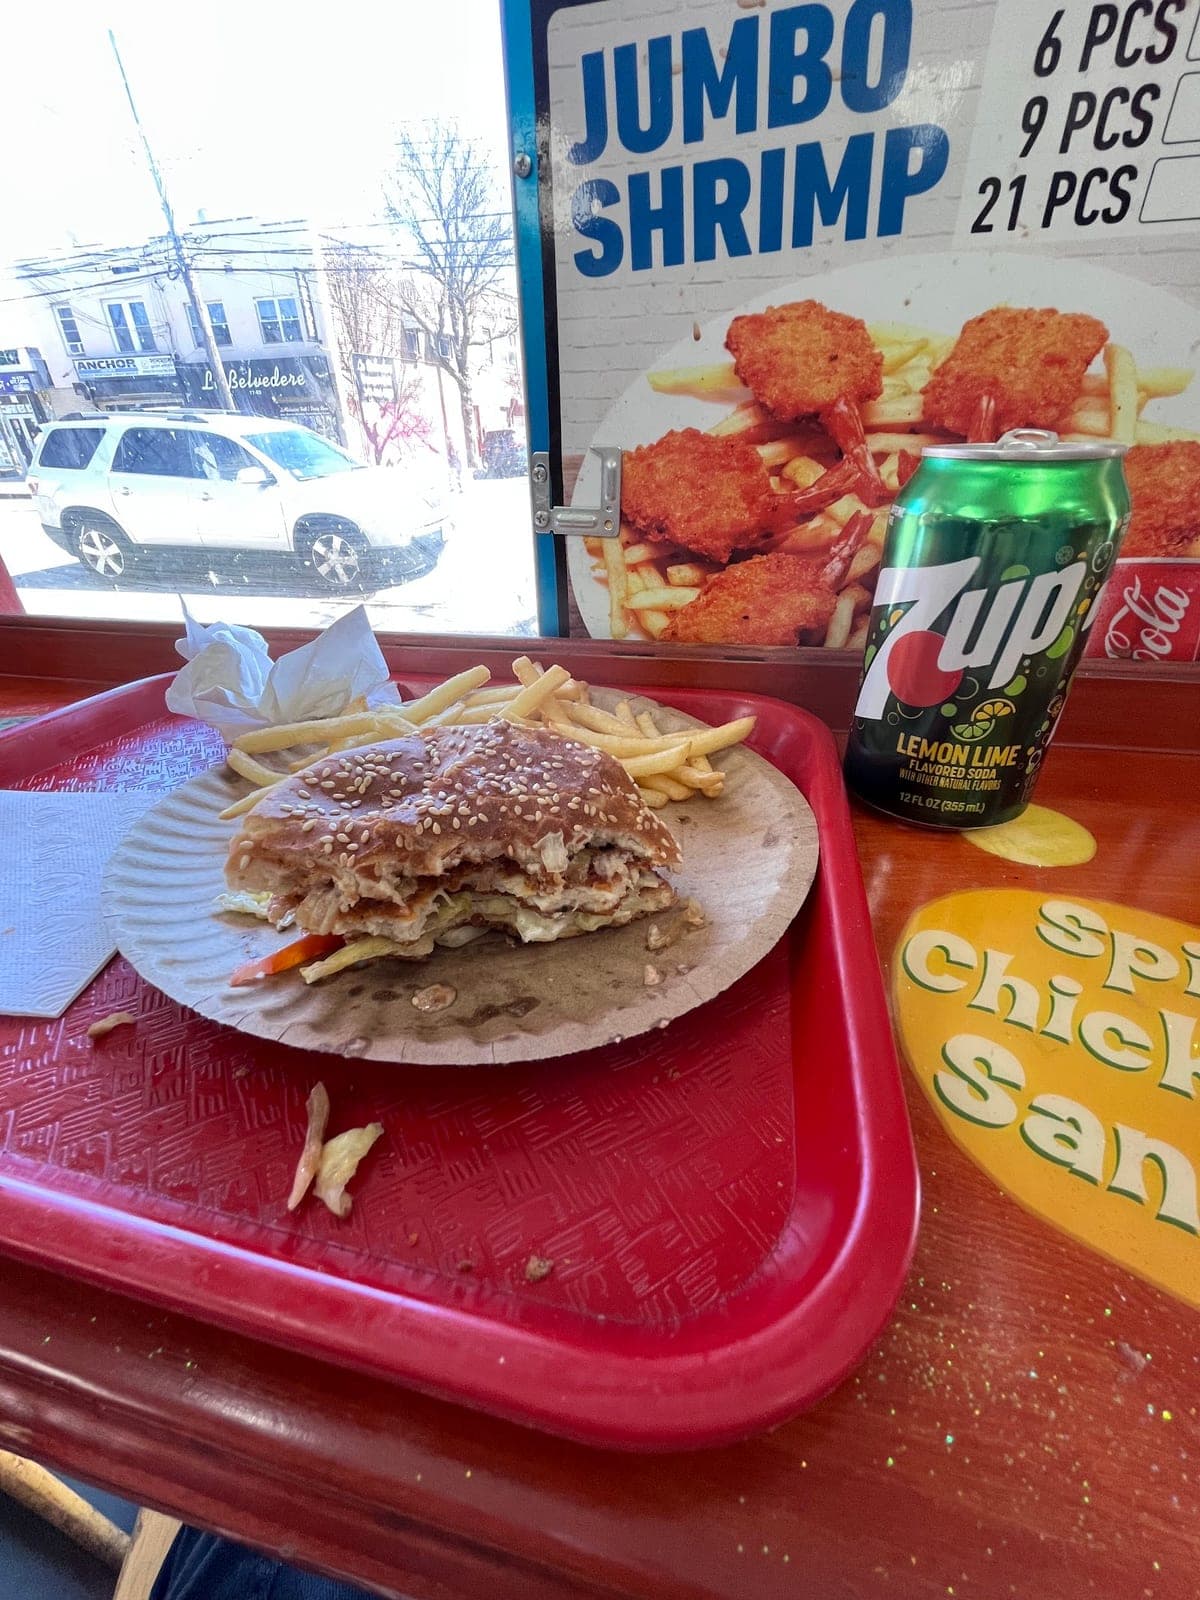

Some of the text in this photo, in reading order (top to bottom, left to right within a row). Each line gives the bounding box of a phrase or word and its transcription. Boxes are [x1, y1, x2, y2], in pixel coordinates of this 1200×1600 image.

[1034, 0, 1186, 77] 6 PCS
[567, 0, 913, 165] JUMBO
[1019, 83, 1161, 158] 9 PCS
[571, 123, 949, 278] SHRIMP
[971, 164, 1138, 234] 21 PCS
[78, 359, 137, 370] ANCHOR
[228, 365, 306, 389] Belvedere
[896, 732, 1022, 767] LEMON LIME
[909, 760, 997, 779] FLAVORED SODA
[900, 792, 911, 803] 12
[911, 795, 926, 808] FL
[925, 799, 941, 810] OZ
[941, 800, 967, 813] (355
[939, 778, 971, 790] NATURAL
[933, 1034, 1200, 1236] San
